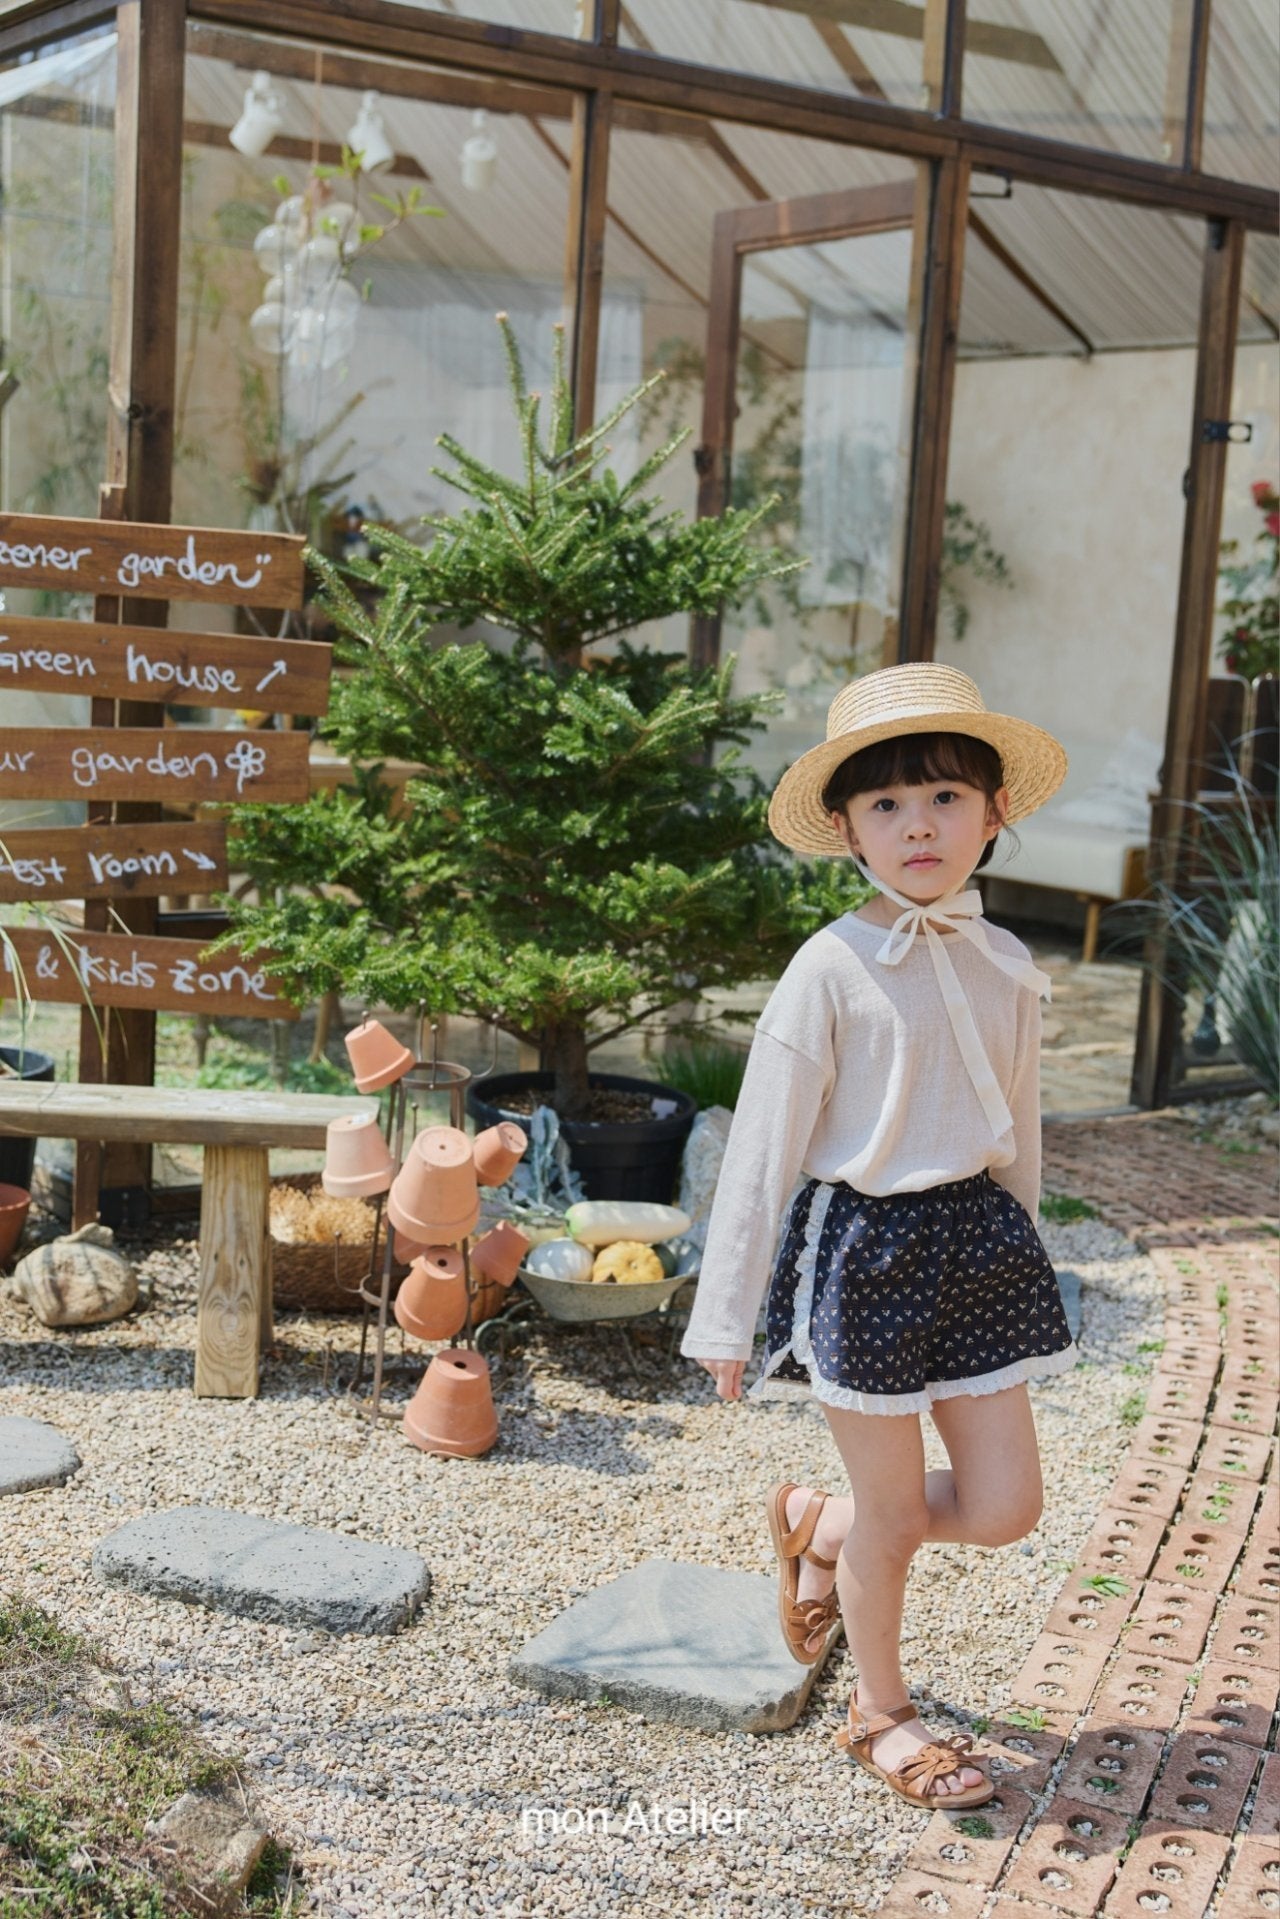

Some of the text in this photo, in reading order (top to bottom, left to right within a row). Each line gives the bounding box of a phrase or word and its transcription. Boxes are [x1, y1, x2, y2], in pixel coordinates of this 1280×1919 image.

[127, 644, 242, 693] house
[71, 742, 218, 786] garden
[0, 851, 176, 886] est room
